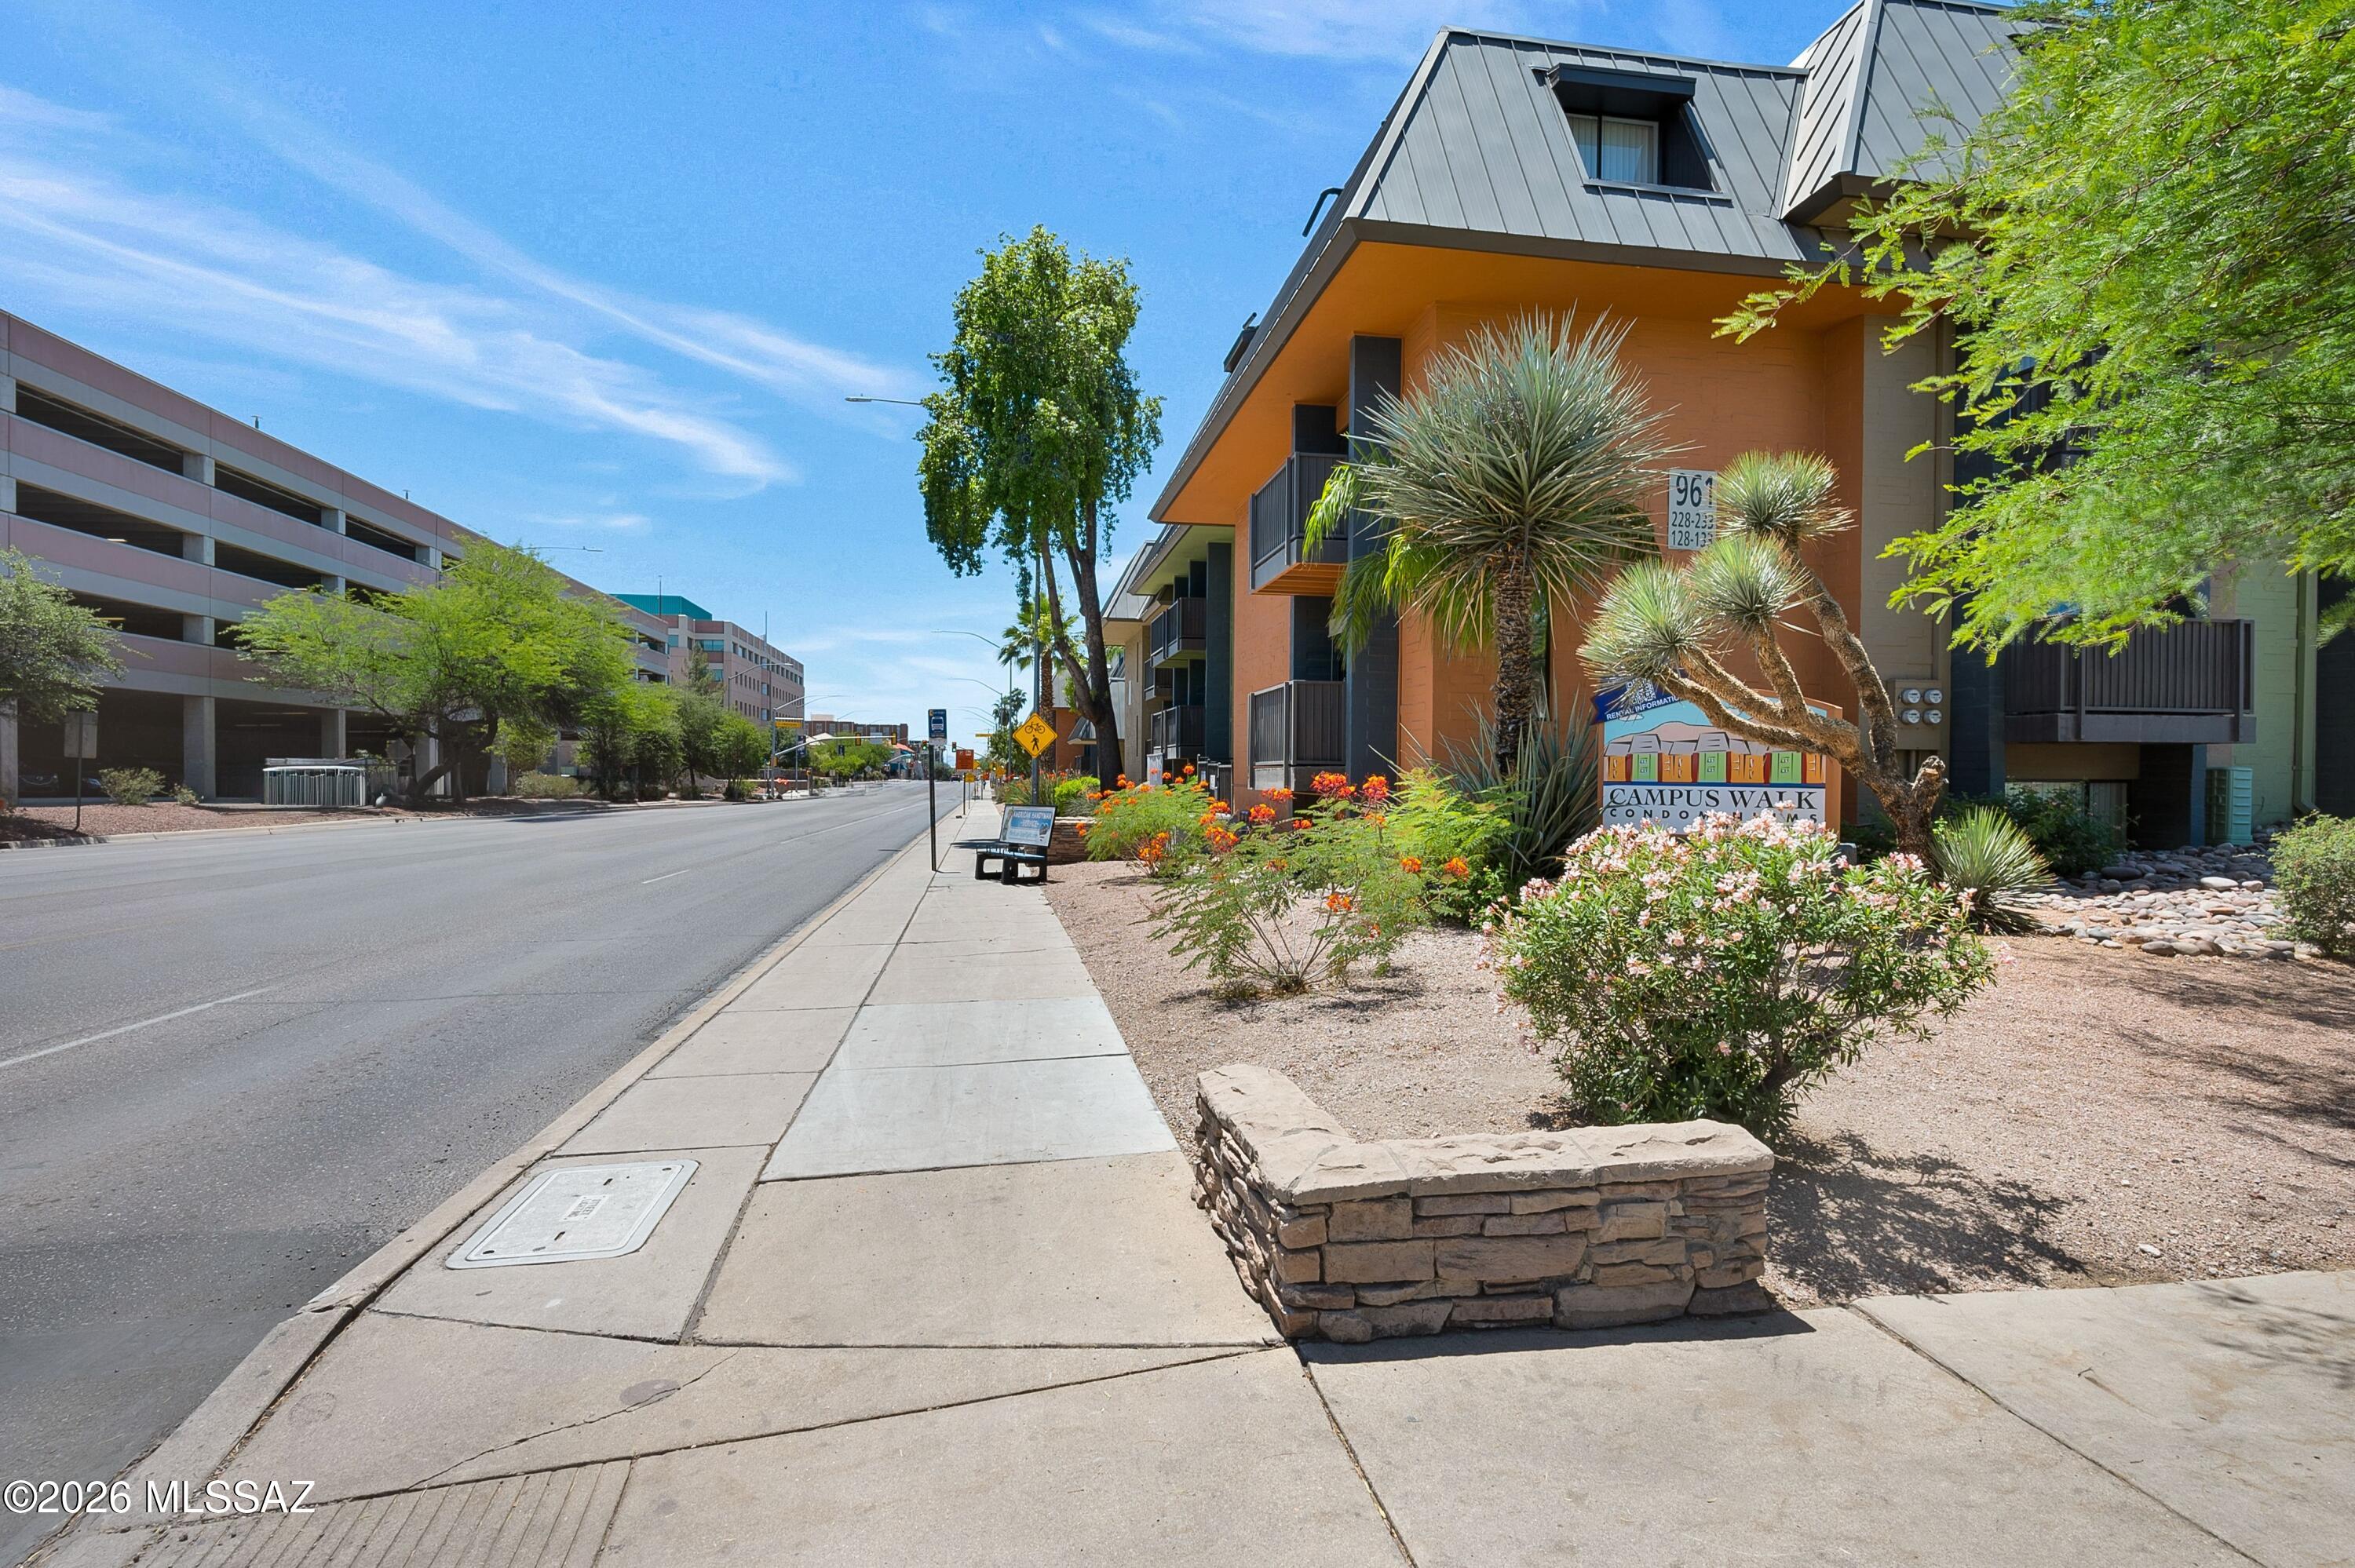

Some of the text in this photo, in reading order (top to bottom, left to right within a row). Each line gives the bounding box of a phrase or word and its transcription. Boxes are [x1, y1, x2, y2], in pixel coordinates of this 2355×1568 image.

[1676, 473, 1713, 508] 961
[1671, 511, 1714, 530] 228-233
[1606, 695, 1679, 720] RENTAL INFORMATIO
[1609, 788, 1818, 810] CAMPUS WALK
